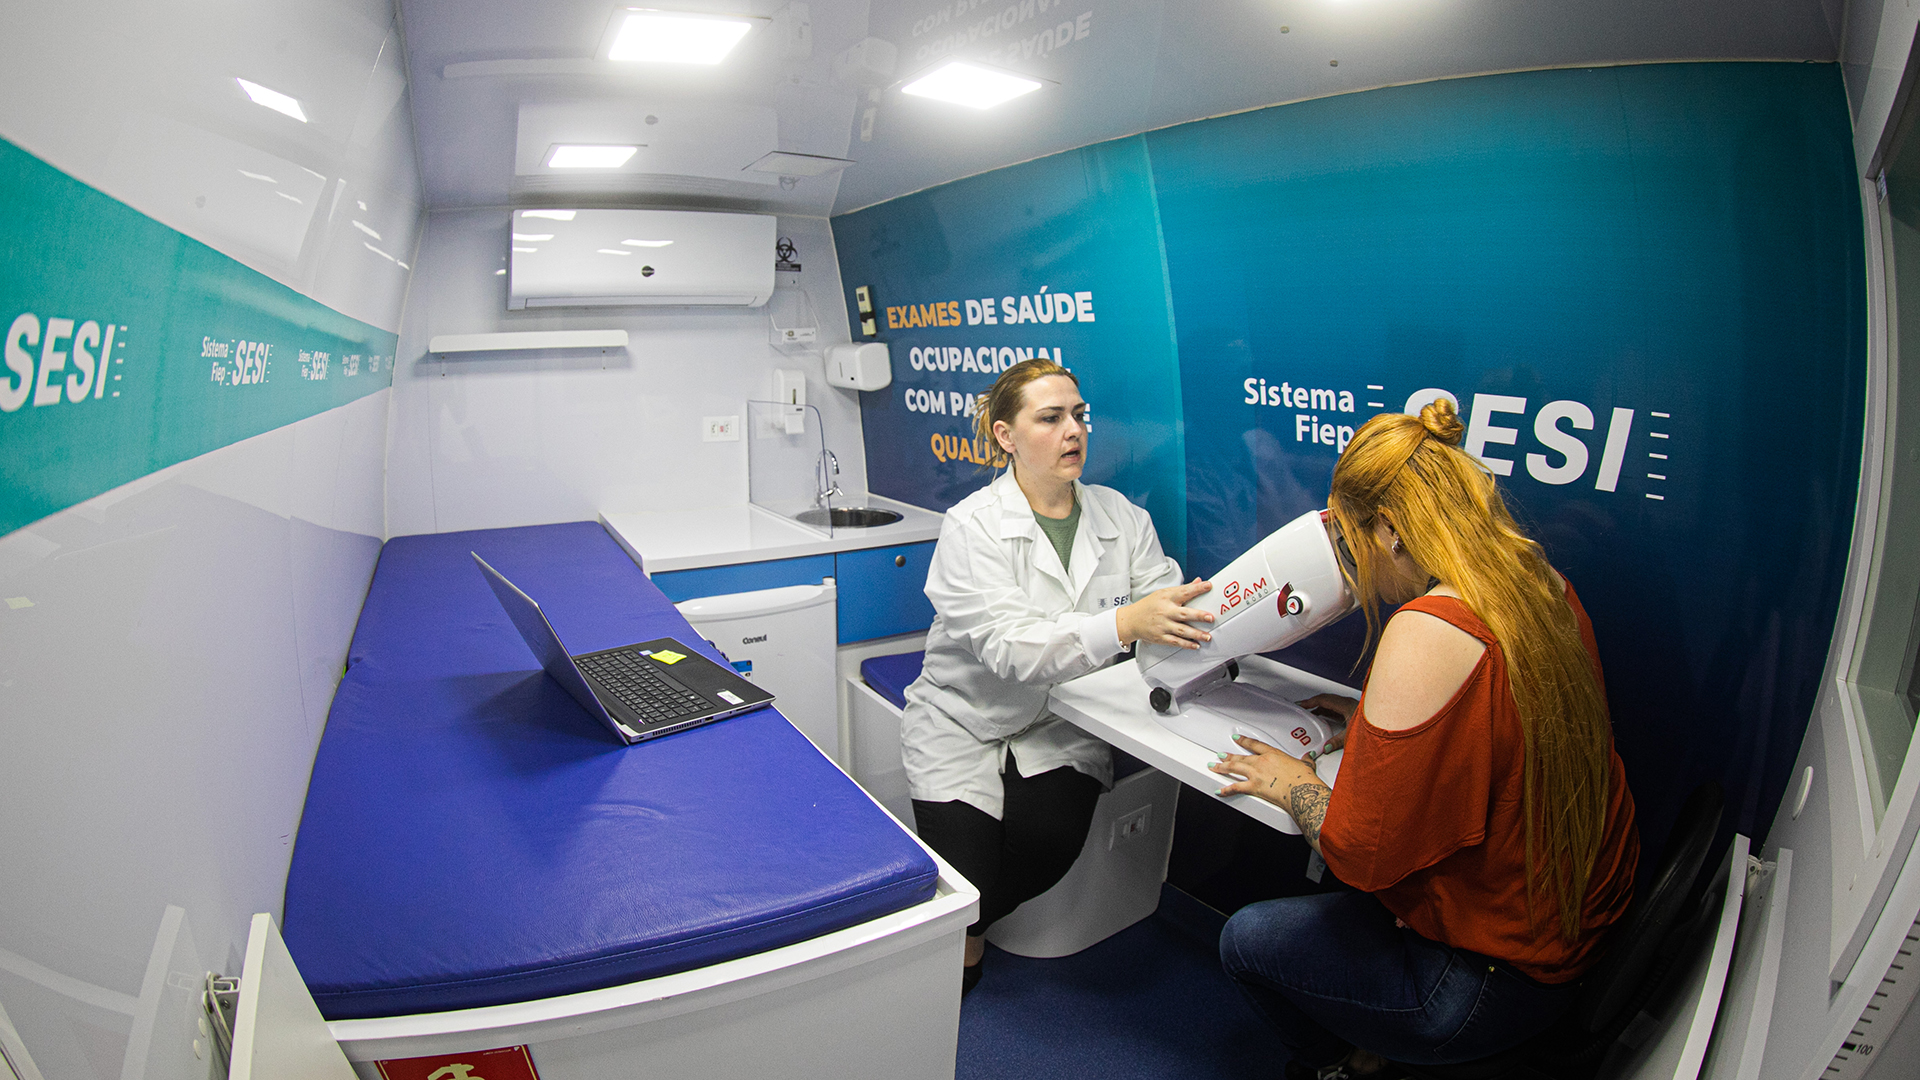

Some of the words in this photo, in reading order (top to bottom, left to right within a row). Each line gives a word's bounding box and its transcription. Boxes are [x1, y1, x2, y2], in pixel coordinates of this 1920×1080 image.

[886, 300, 962, 329] EXAMES
[965, 298, 998, 326] DE
[1001, 285, 1096, 325] SAÚDE
[0, 312, 117, 413] SESI
[201, 335, 229, 358] Sistema
[232, 339, 270, 386] SESI
[211, 362, 226, 387] Fiep
[905, 388, 946, 415] COM
[1243, 377, 1355, 413] Sistema
[1295, 413, 1355, 454] Fiep
[1220, 577, 1267, 616] ADAM
[1856, 1044, 1874, 1056] 100
